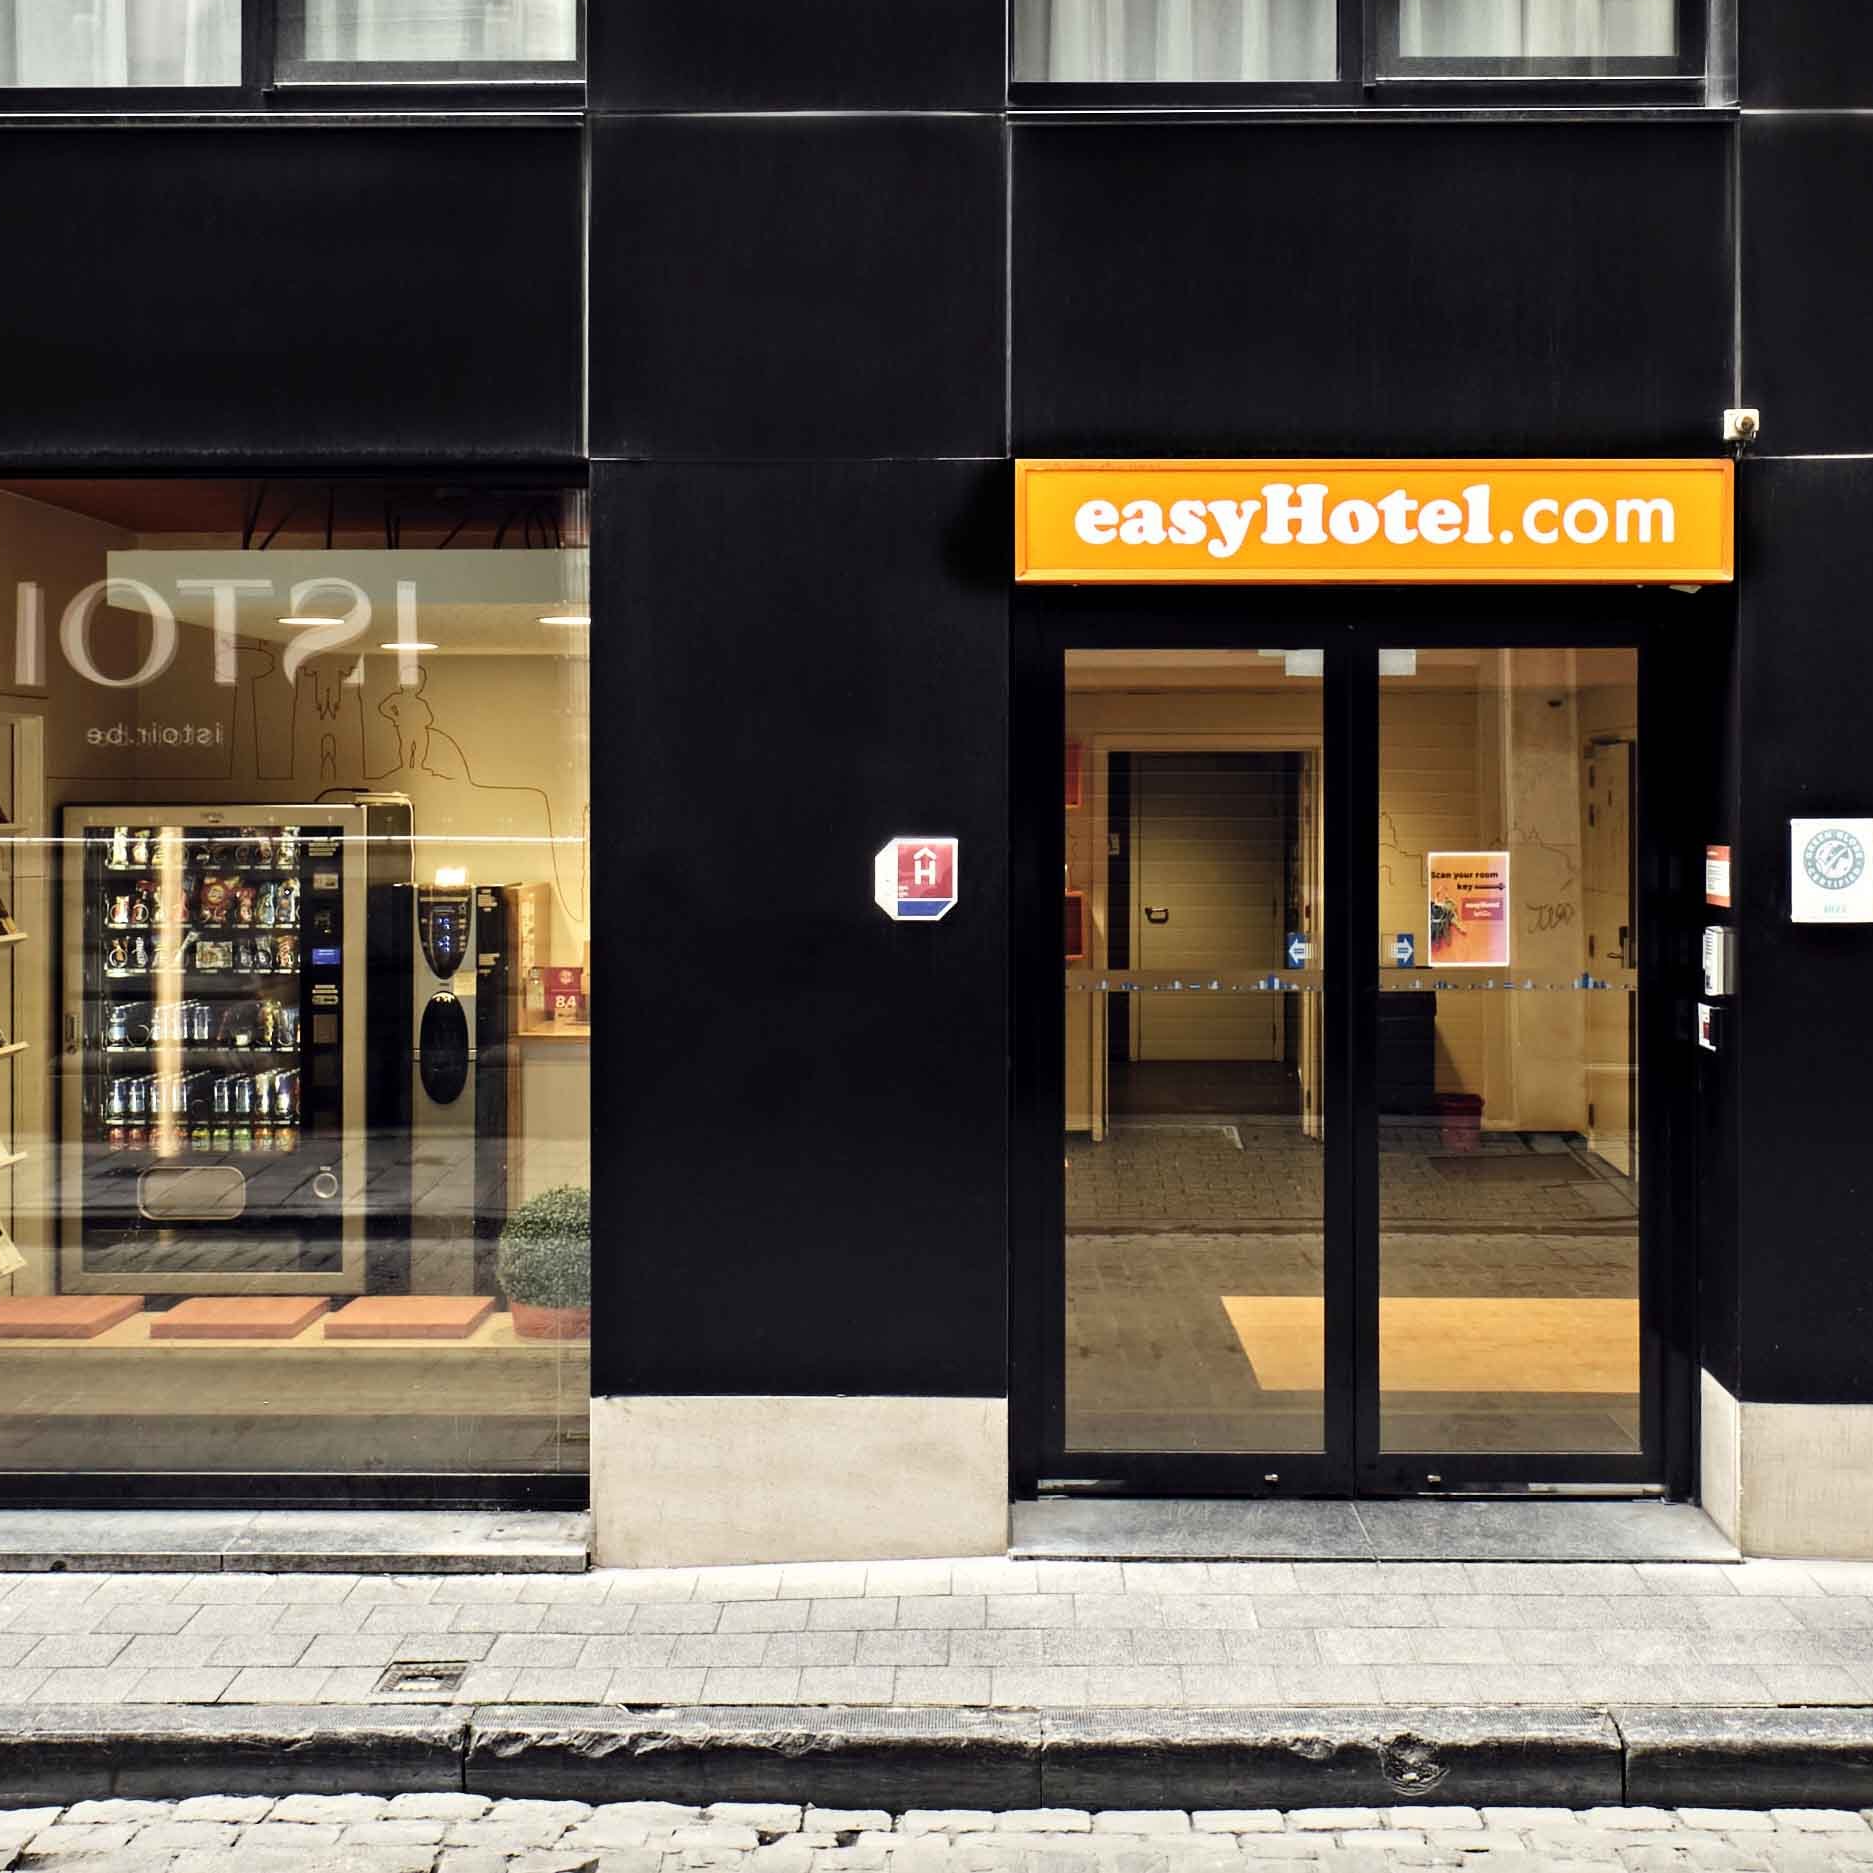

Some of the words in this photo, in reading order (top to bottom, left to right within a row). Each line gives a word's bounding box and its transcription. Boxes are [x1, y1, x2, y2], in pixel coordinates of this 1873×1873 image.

[1074, 483, 1675, 558] easyHotel.com
[1454, 871, 1474, 881] your
[1475, 871, 1499, 879] room
